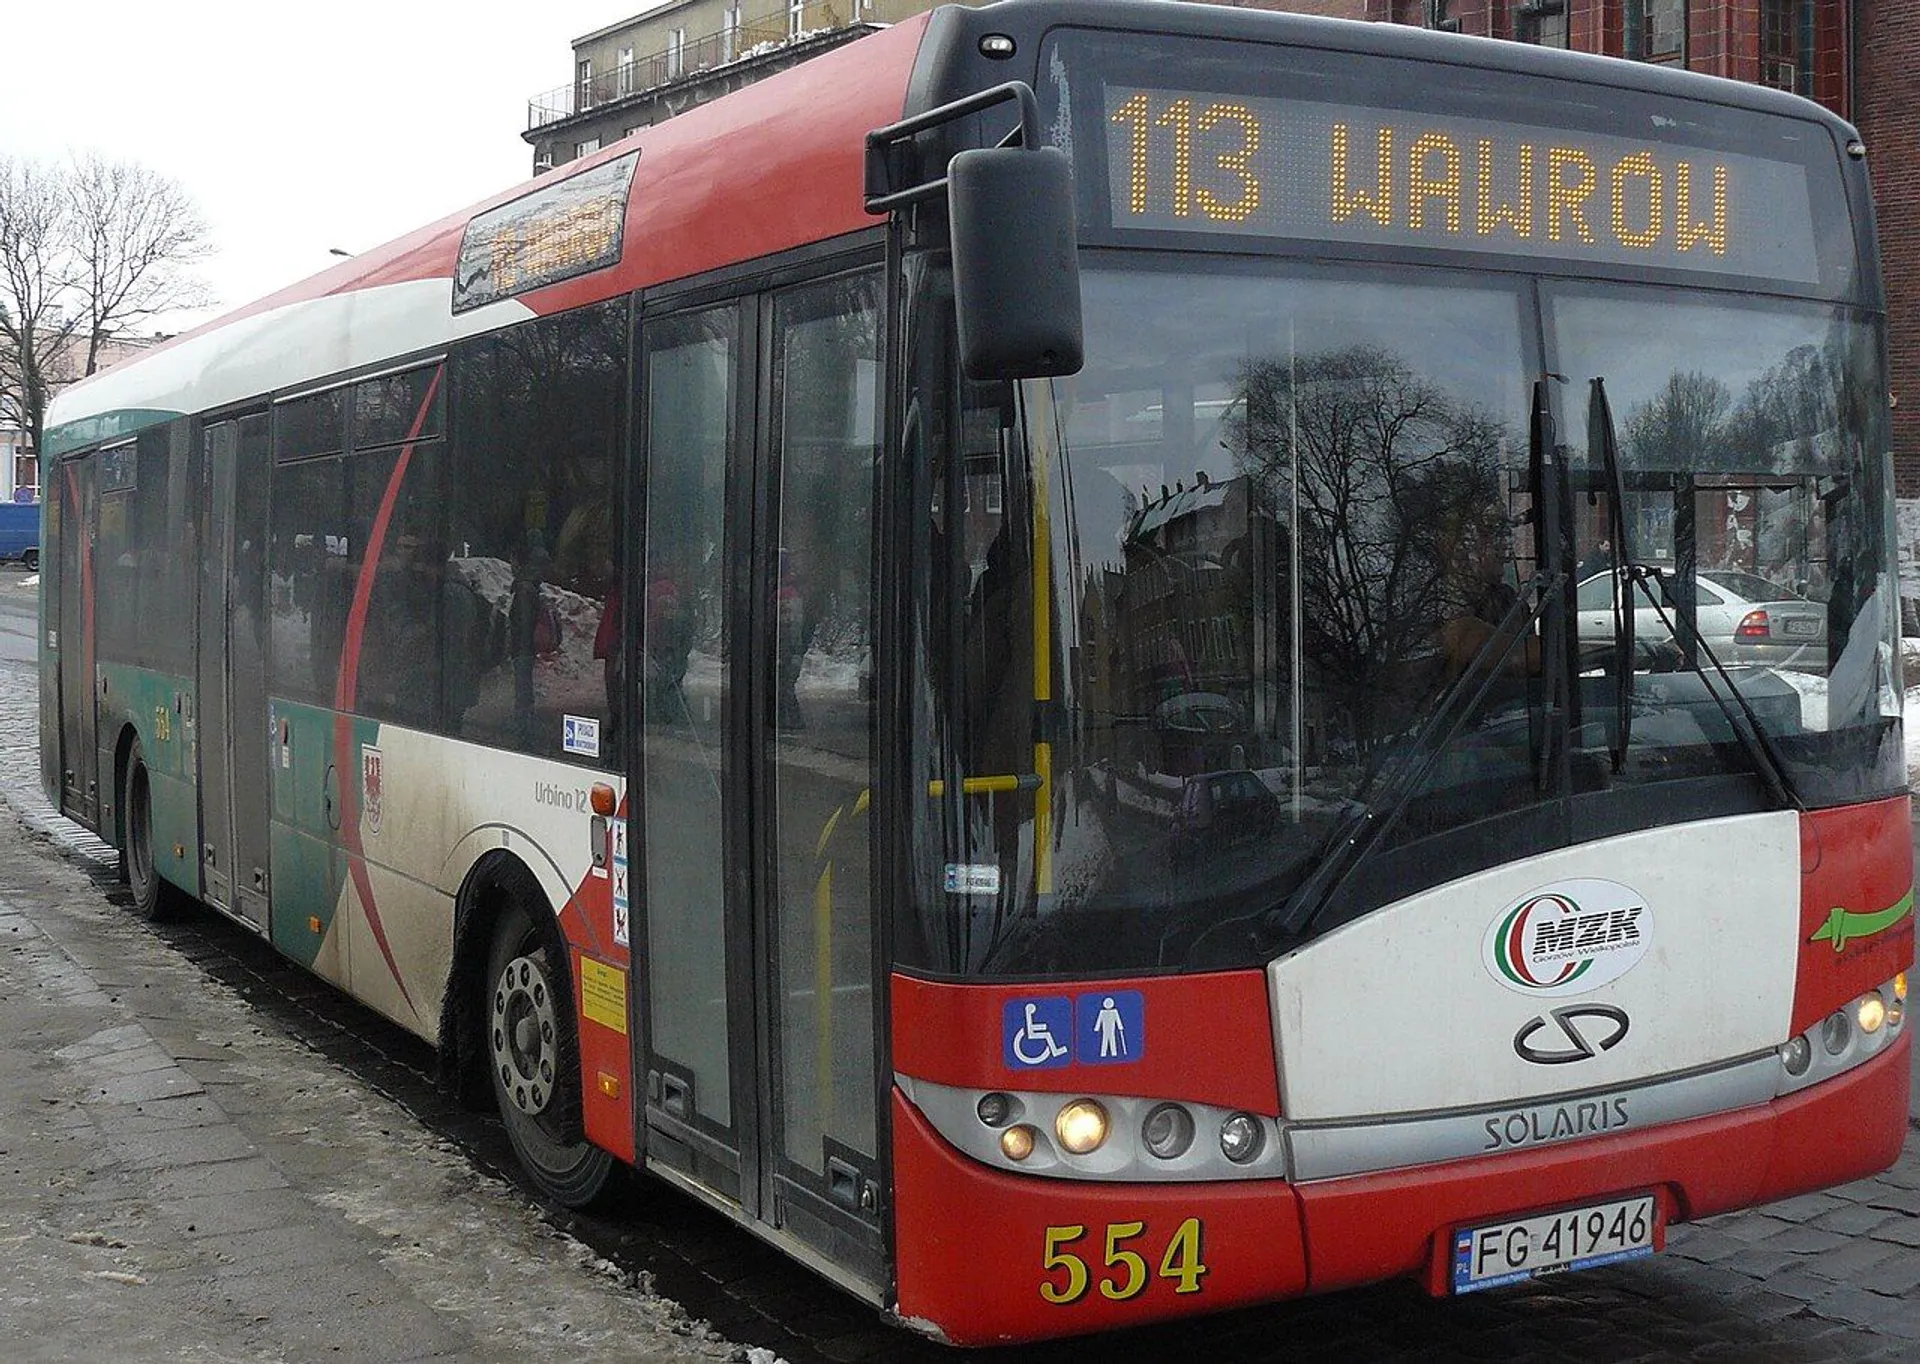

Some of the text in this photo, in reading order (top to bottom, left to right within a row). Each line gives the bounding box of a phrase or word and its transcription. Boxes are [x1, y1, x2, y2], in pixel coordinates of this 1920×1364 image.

[1110, 94, 1729, 256] 113 WAWRÓW
[535, 781, 587, 814] Urbino 12
[1532, 907, 1642, 955] MZK
[1485, 1097, 1629, 1149] SOLARIS
[1039, 1217, 1209, 1304] 554
[1477, 1226, 1529, 1275] FG
[1541, 1202, 1647, 1260] 41946
